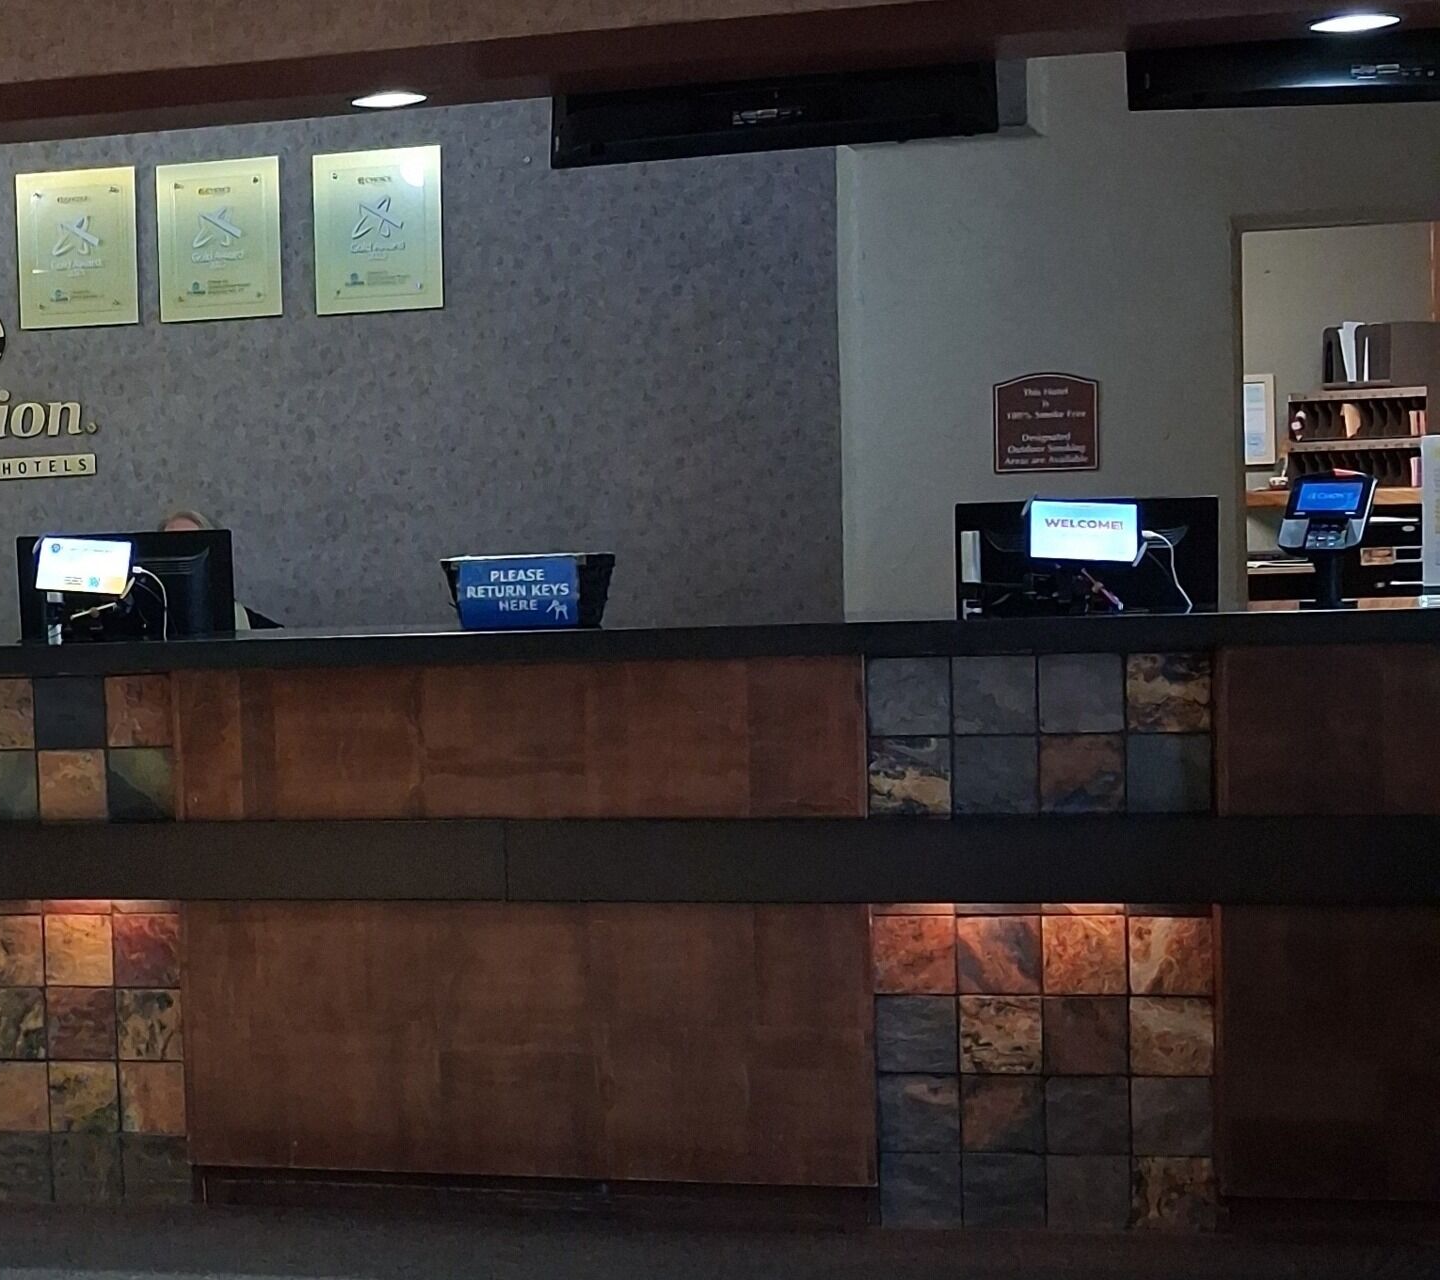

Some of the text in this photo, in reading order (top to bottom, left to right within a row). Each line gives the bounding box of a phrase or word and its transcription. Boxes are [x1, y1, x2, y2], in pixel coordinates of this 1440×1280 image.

[2, 458, 88, 475] HOTELS
[1044, 518, 1124, 530] WELCOME!
[490, 569, 545, 582] PLEASE
[466, 583, 569, 598] RETURN KEYS
[499, 599, 538, 611] HERE
